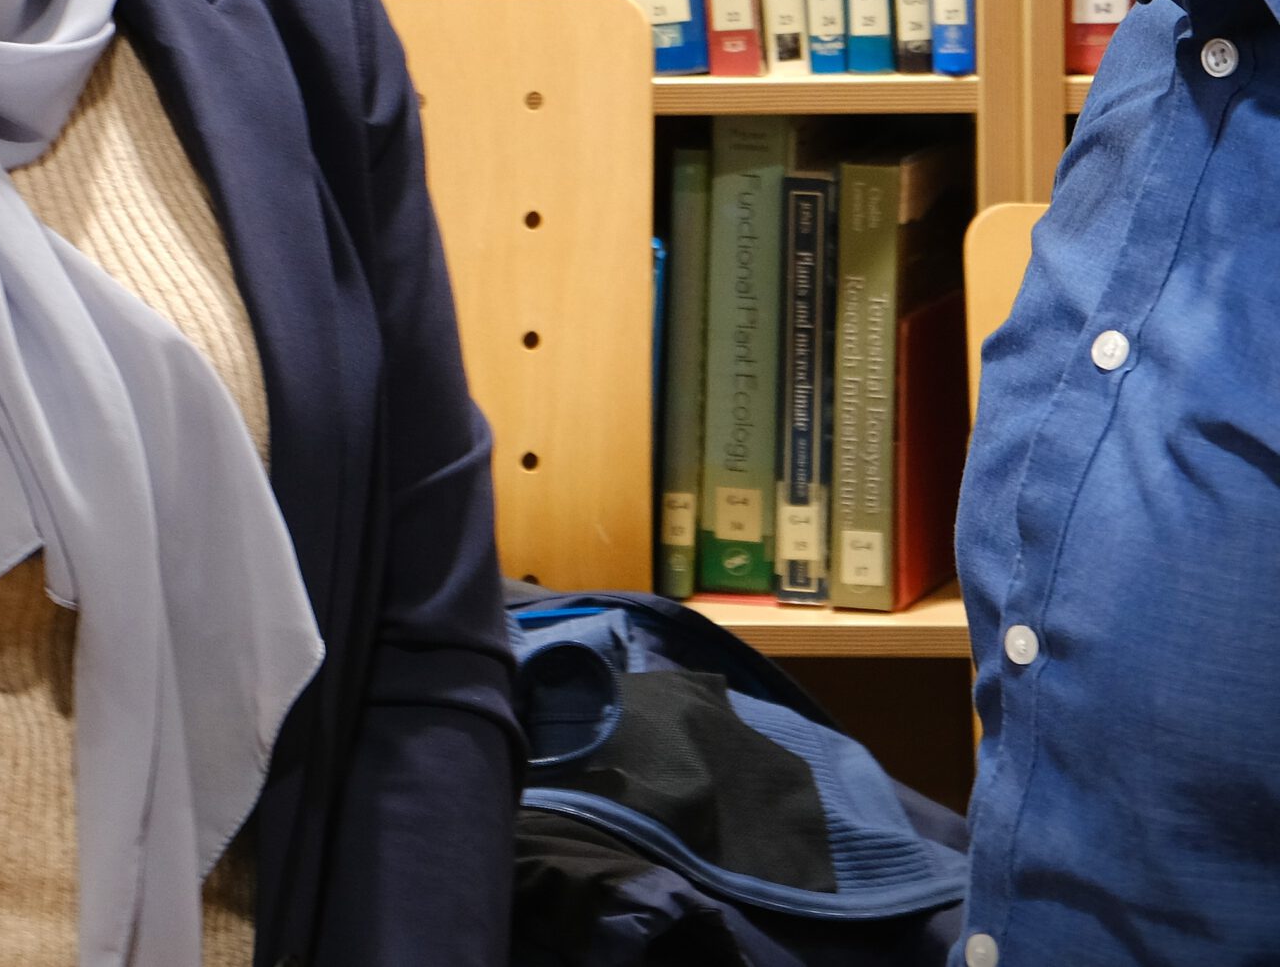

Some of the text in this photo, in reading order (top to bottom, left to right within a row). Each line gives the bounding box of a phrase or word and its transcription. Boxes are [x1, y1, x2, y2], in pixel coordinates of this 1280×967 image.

[734, 173, 762, 301] Functional
[795, 252, 816, 297] Plants
[734, 306, 760, 366] Plant
[795, 300, 816, 329] and
[724, 373, 758, 474] Ecology
[792, 334, 816, 432] microclimate
[840, 276, 866, 532] Research Infrastructures
[859, 293, 890, 514] Terrestrial Ecosystem
